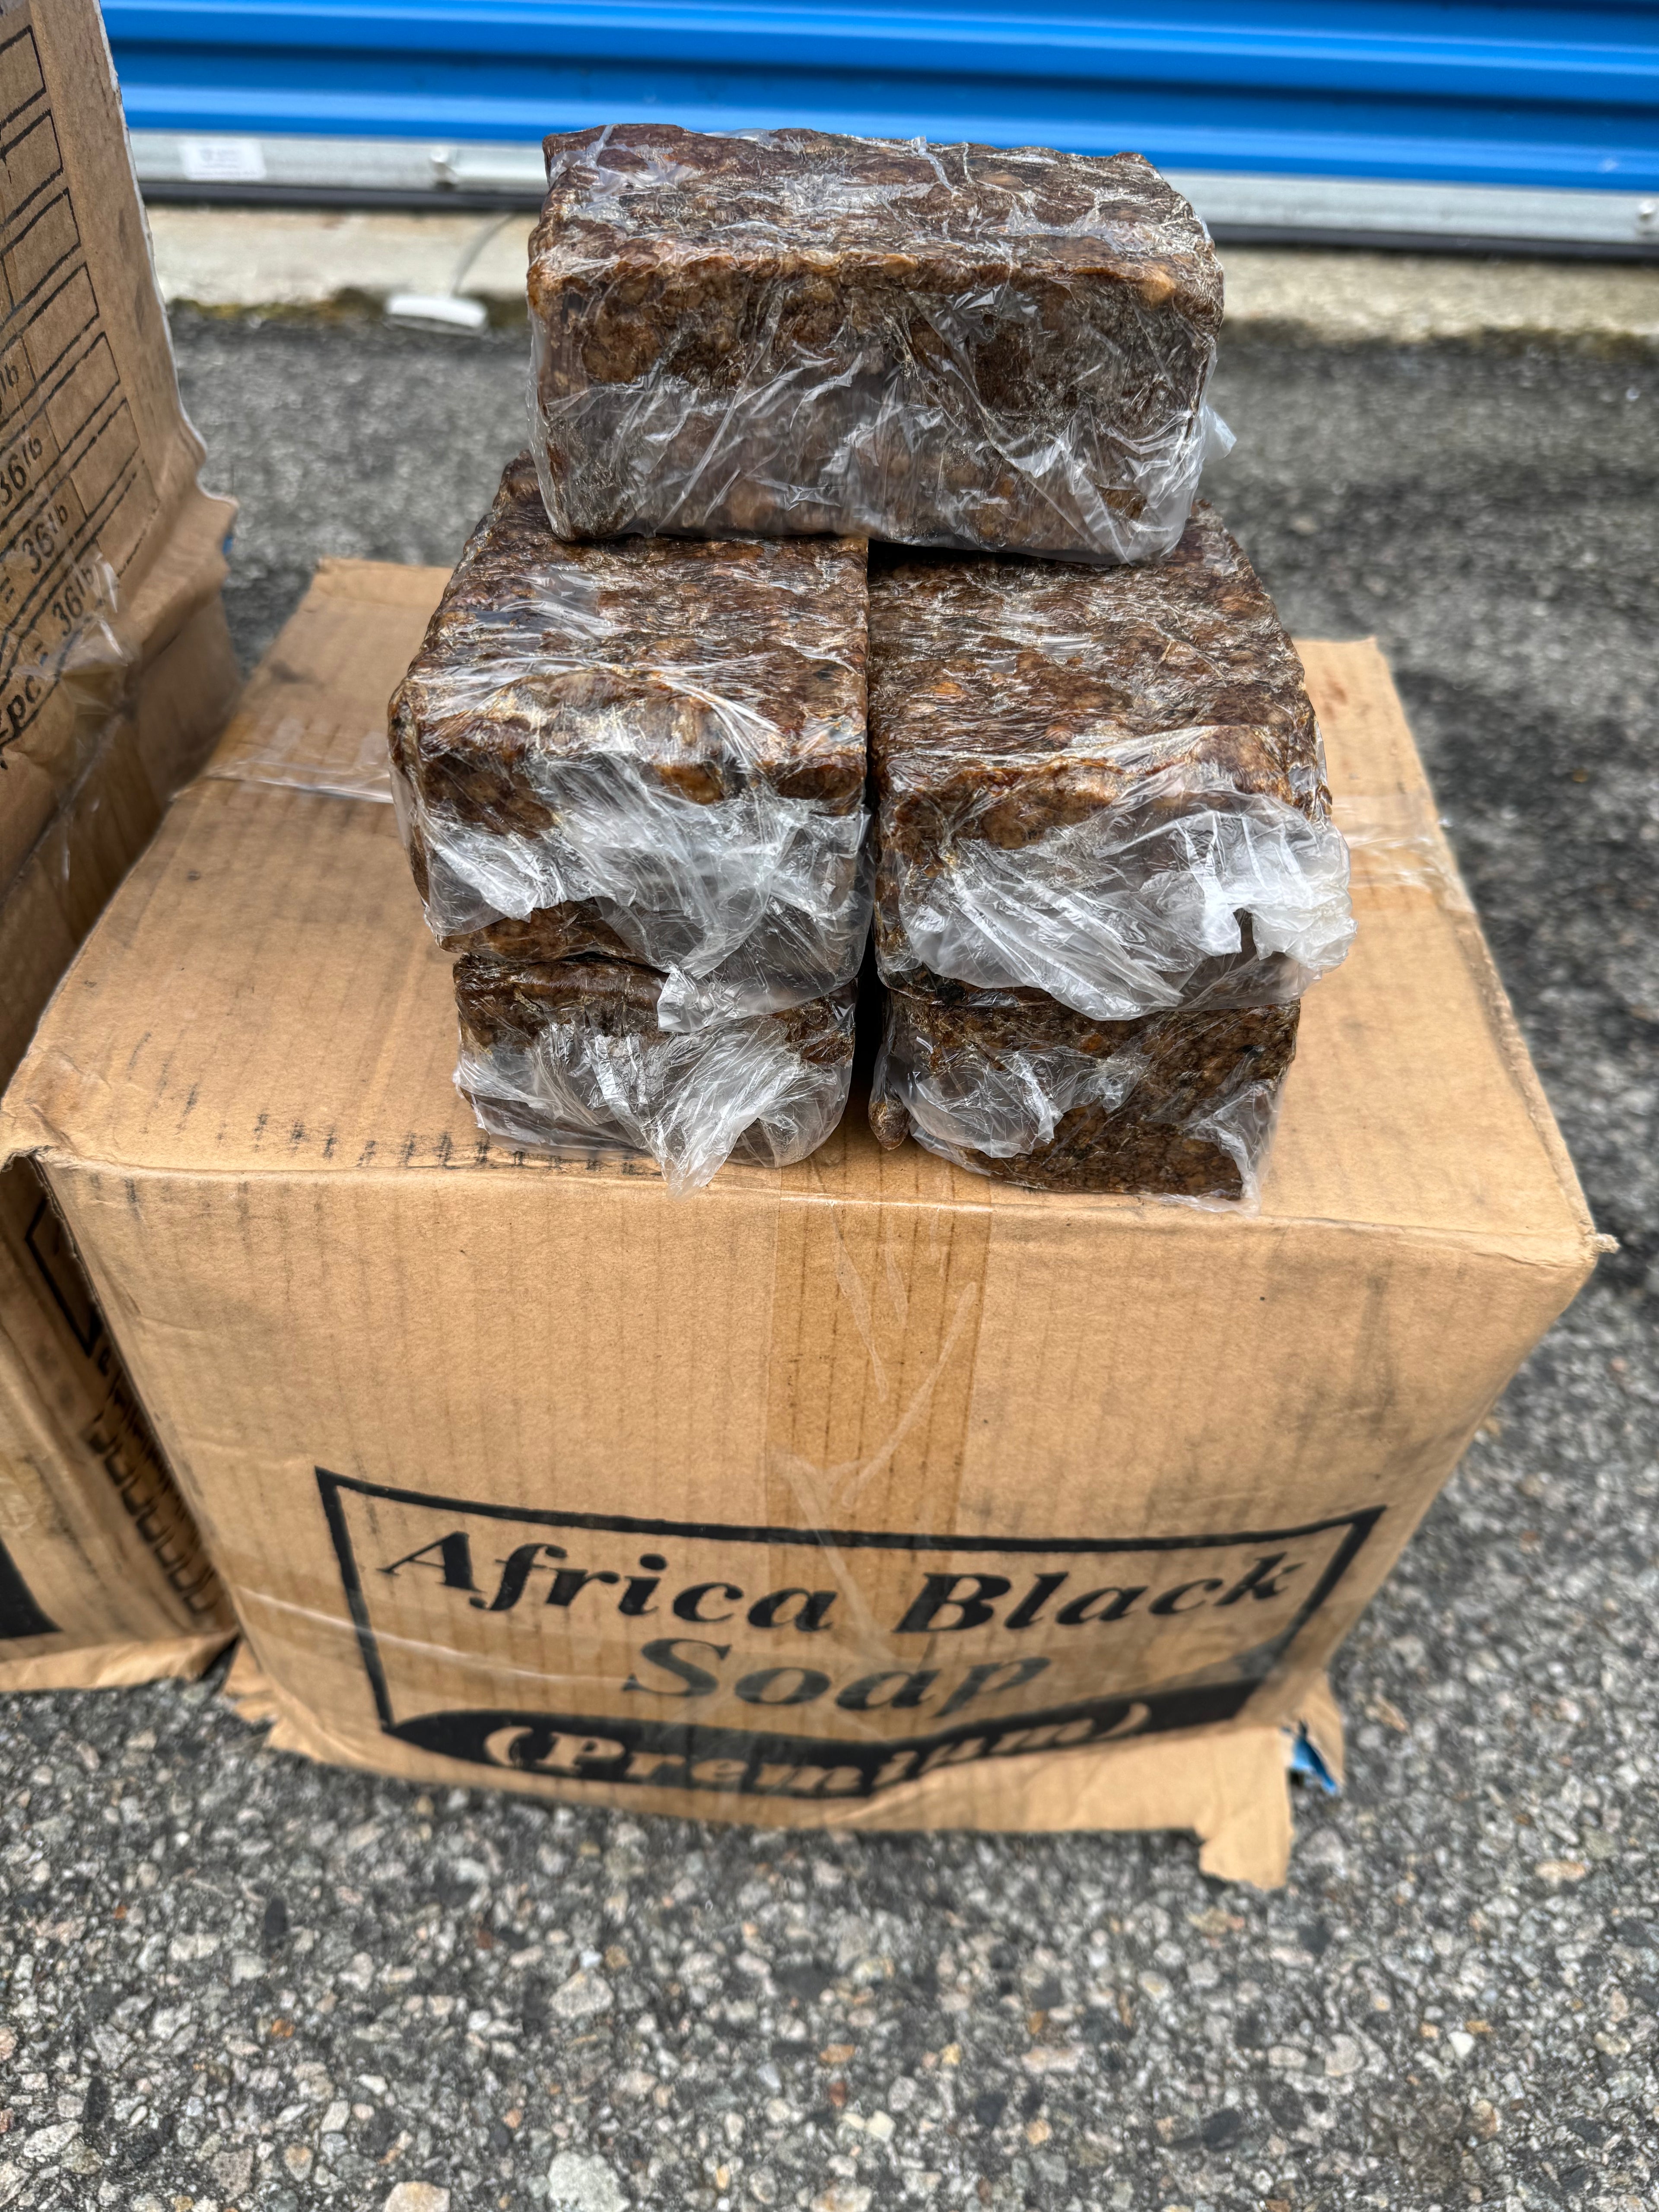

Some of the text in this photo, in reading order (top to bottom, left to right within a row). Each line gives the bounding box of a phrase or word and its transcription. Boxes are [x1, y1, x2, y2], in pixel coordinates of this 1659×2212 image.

[375, 1530, 1307, 1634] Africa Black
[621, 1637, 1052, 1718] Soap
